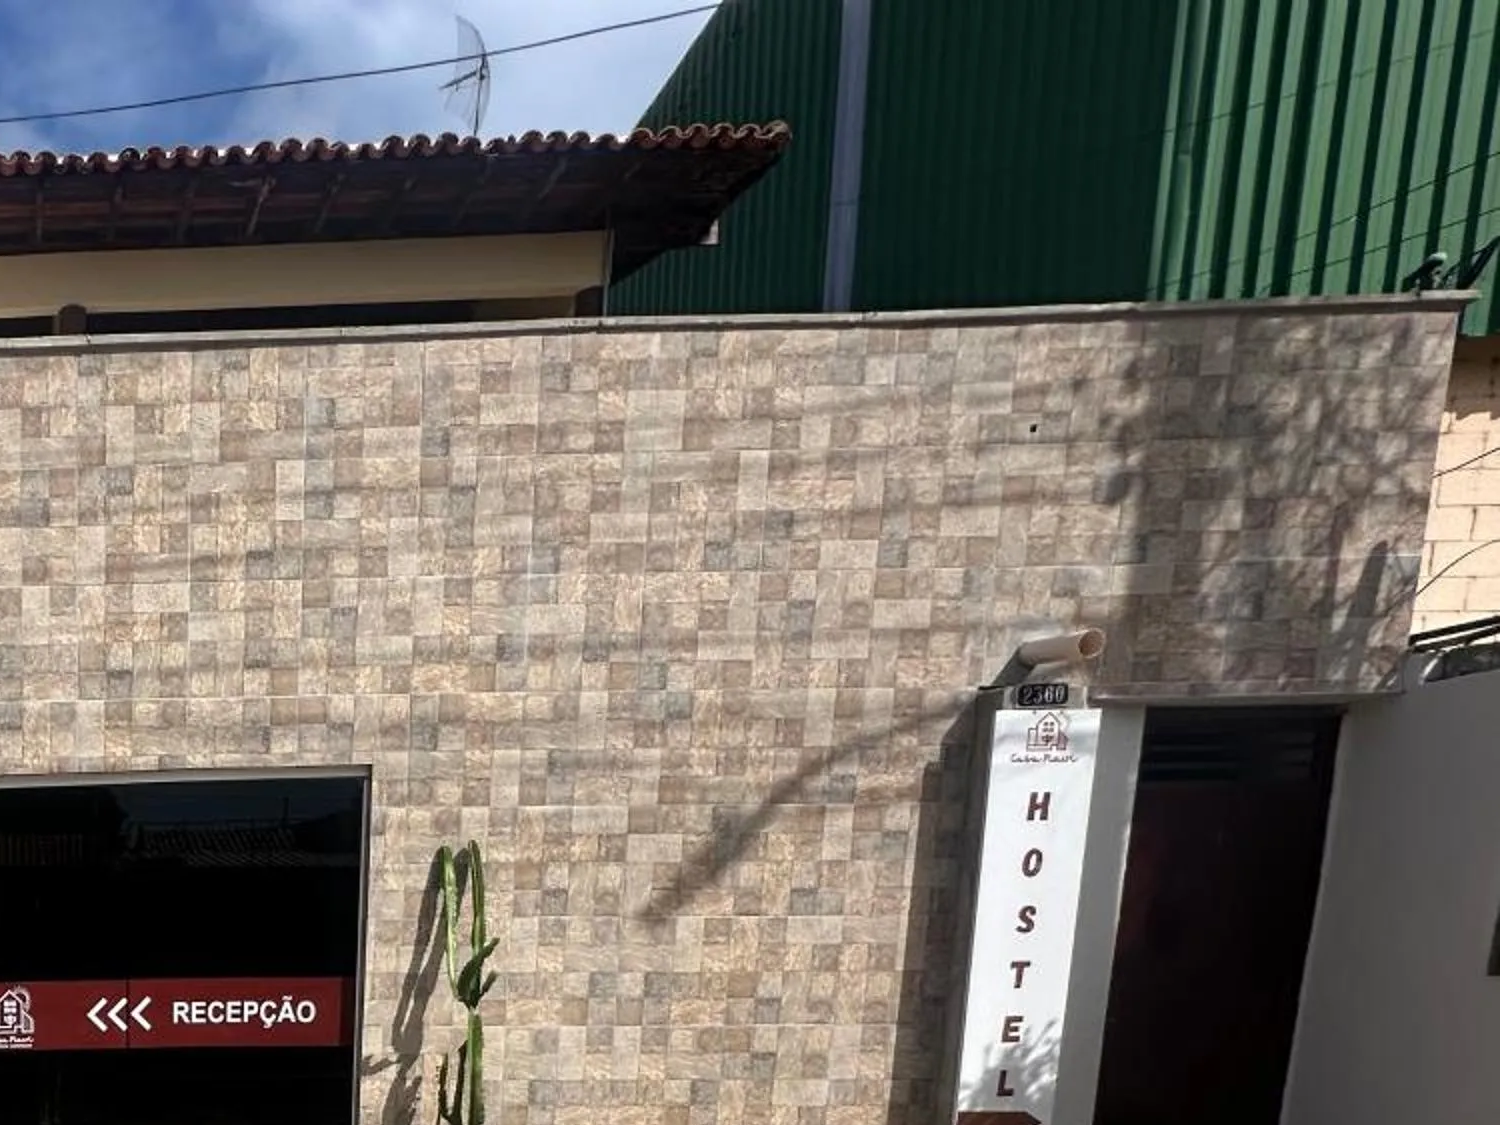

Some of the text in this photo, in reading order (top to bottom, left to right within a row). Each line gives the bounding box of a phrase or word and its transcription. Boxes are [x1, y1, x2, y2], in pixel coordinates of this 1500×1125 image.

[1022, 685, 1065, 705] 2360
[996, 791, 1051, 1097] HOSTEL
[173, 996, 316, 1029] RECEPÇÃO
